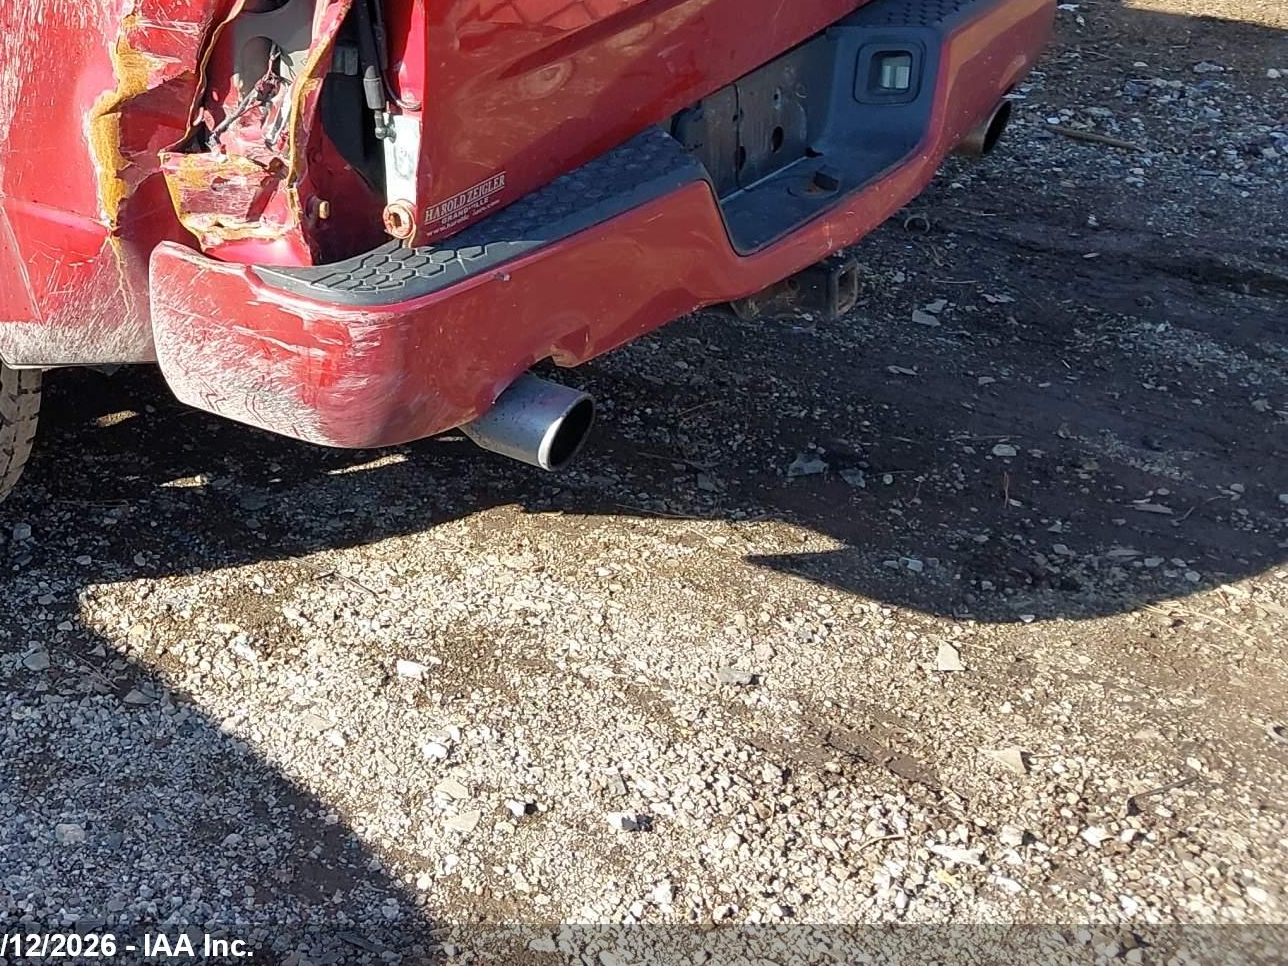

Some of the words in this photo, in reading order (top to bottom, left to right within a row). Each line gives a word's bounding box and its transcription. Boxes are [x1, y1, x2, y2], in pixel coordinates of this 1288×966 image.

[425, 195, 465, 223] HAROLD
[467, 175, 505, 203] ZEIGLER
[441, 197, 489, 224] GRANDILLE
